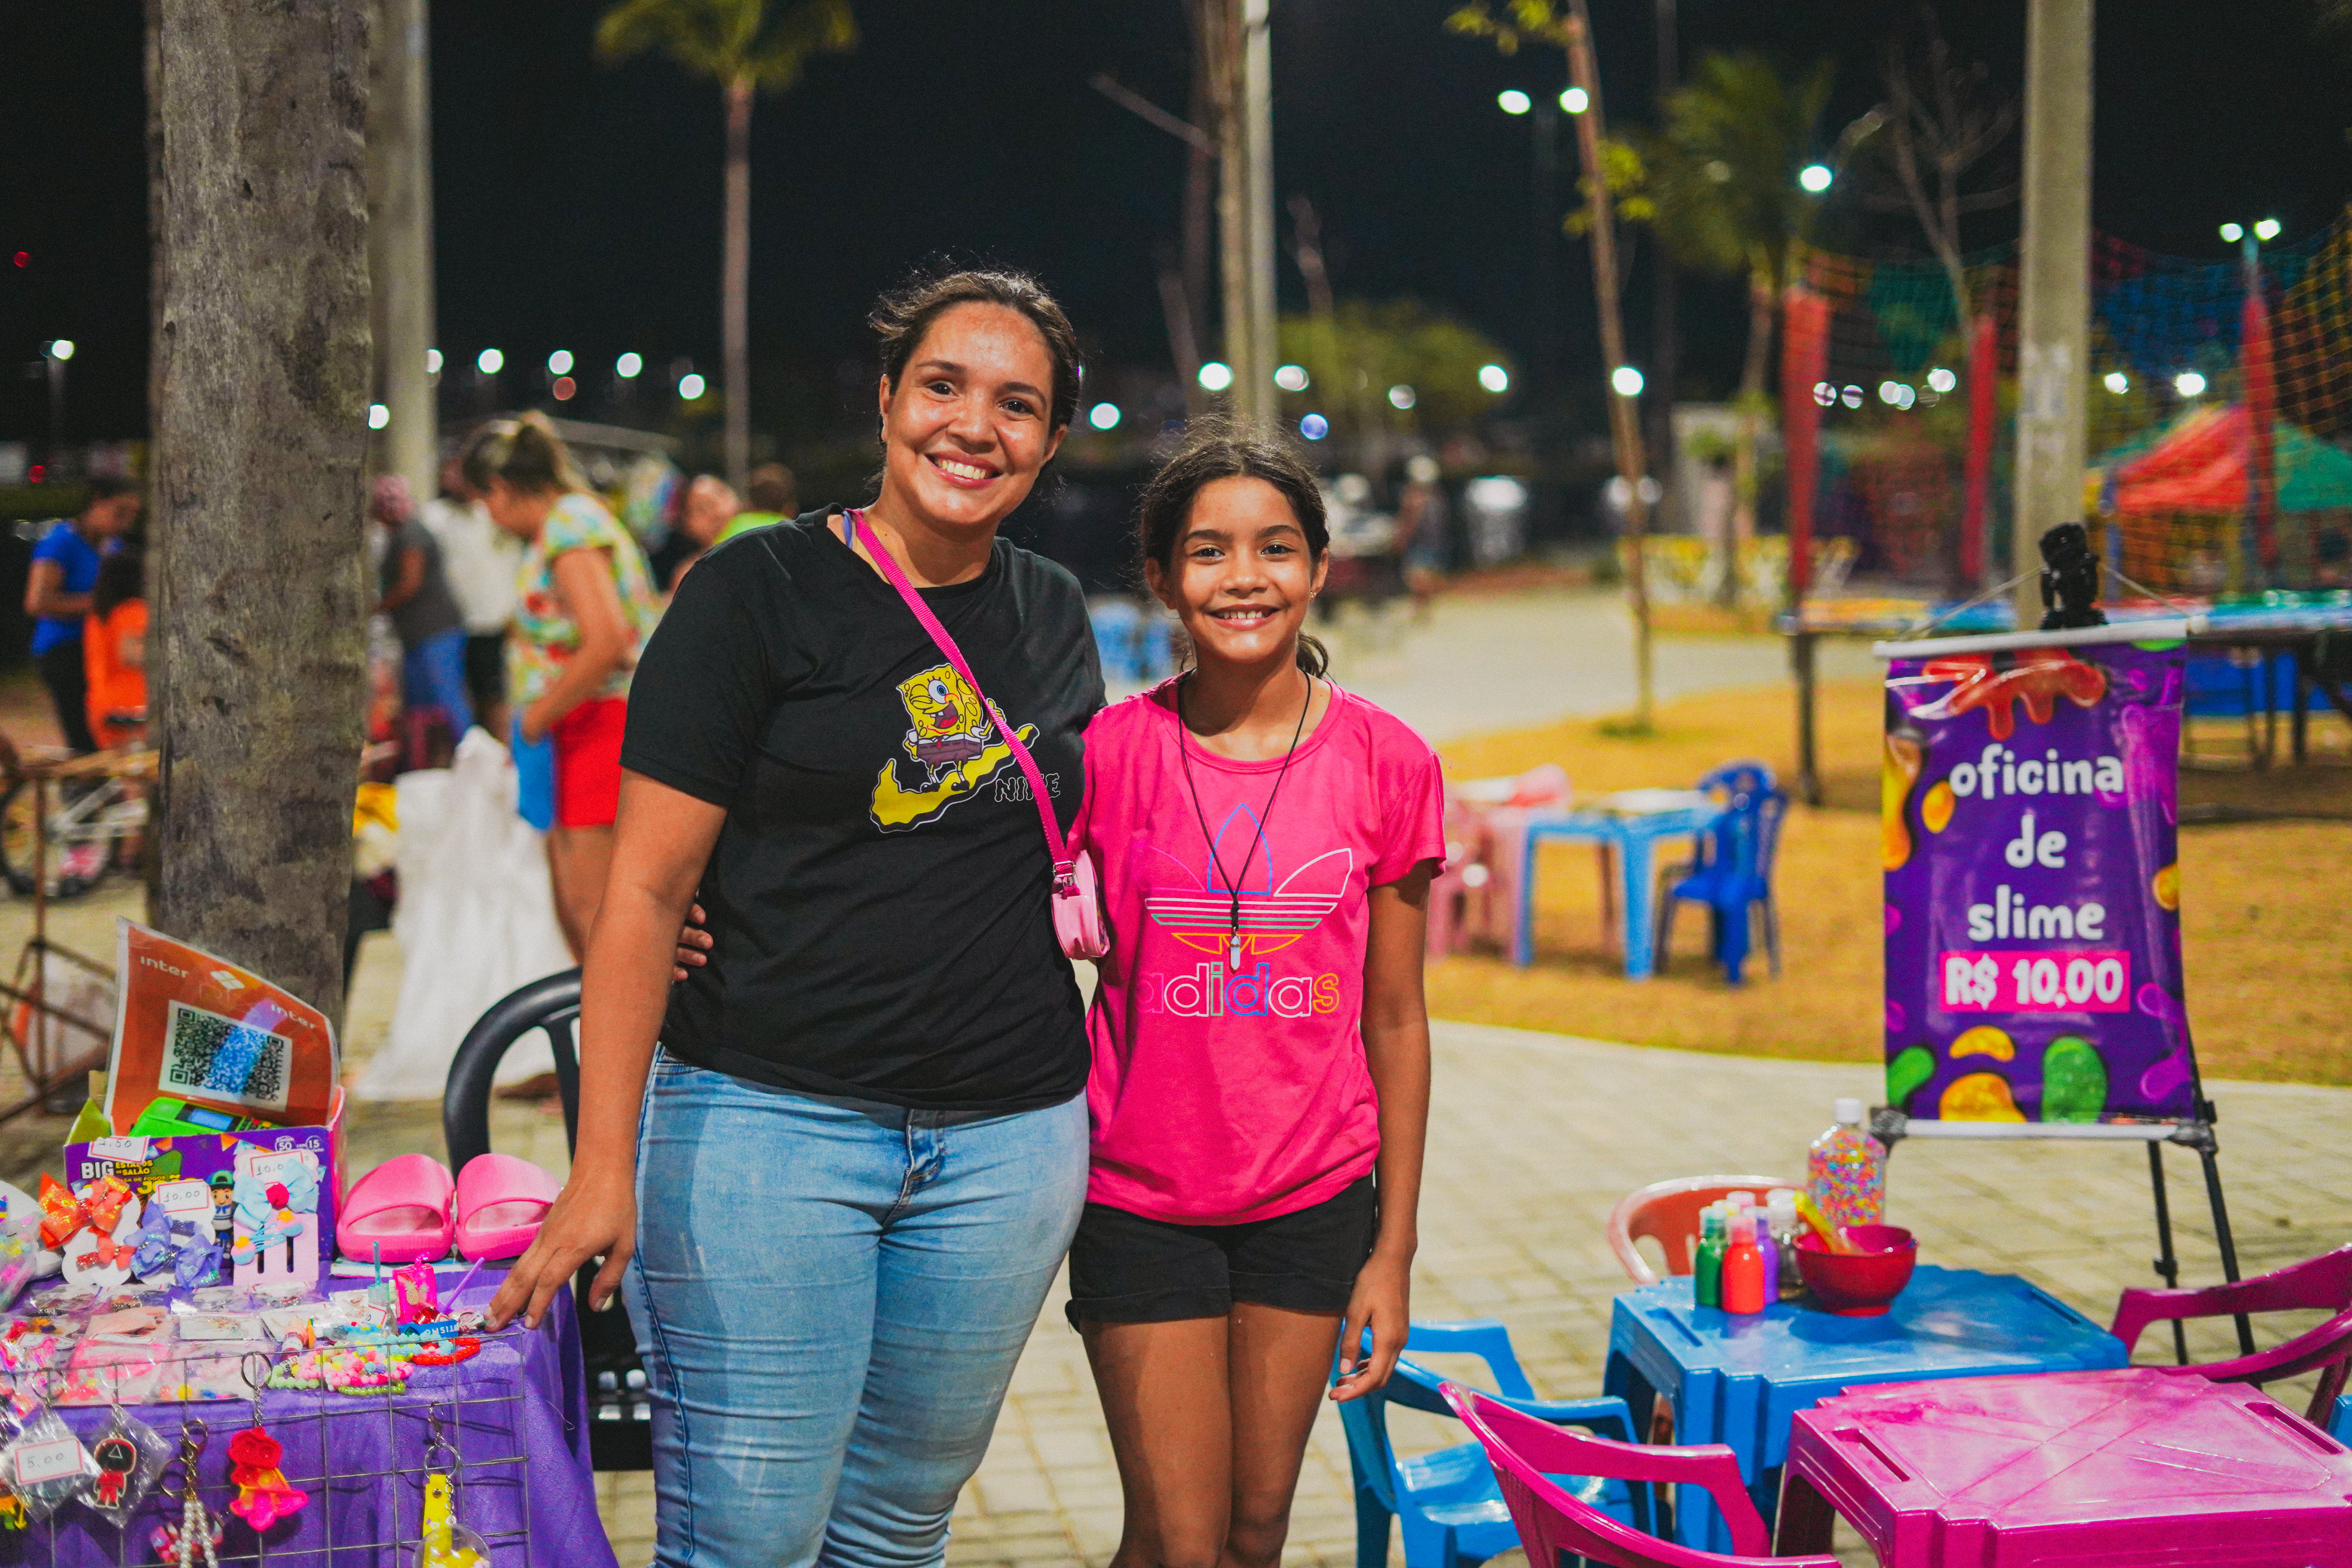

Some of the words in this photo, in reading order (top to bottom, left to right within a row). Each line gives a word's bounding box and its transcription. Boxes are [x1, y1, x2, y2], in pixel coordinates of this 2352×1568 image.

[1949, 743, 2124, 800] oficina
[2005, 813, 2067, 869] de
[1967, 884, 2106, 942] slime
[140, 956, 189, 978] inter
[1137, 961, 1340, 1018] adidas
[1946, 953, 1999, 1010] R$
[2012, 958, 2124, 1009] 10,00
[270, 1003, 317, 1030] inter
[278, 1141, 292, 1151] 50
[308, 1139, 320, 1149] 15
[81, 1160, 114, 1179] BIG
[122, 1166, 150, 1176] SALÃO
[163, 1190, 200, 1202] 10,00
